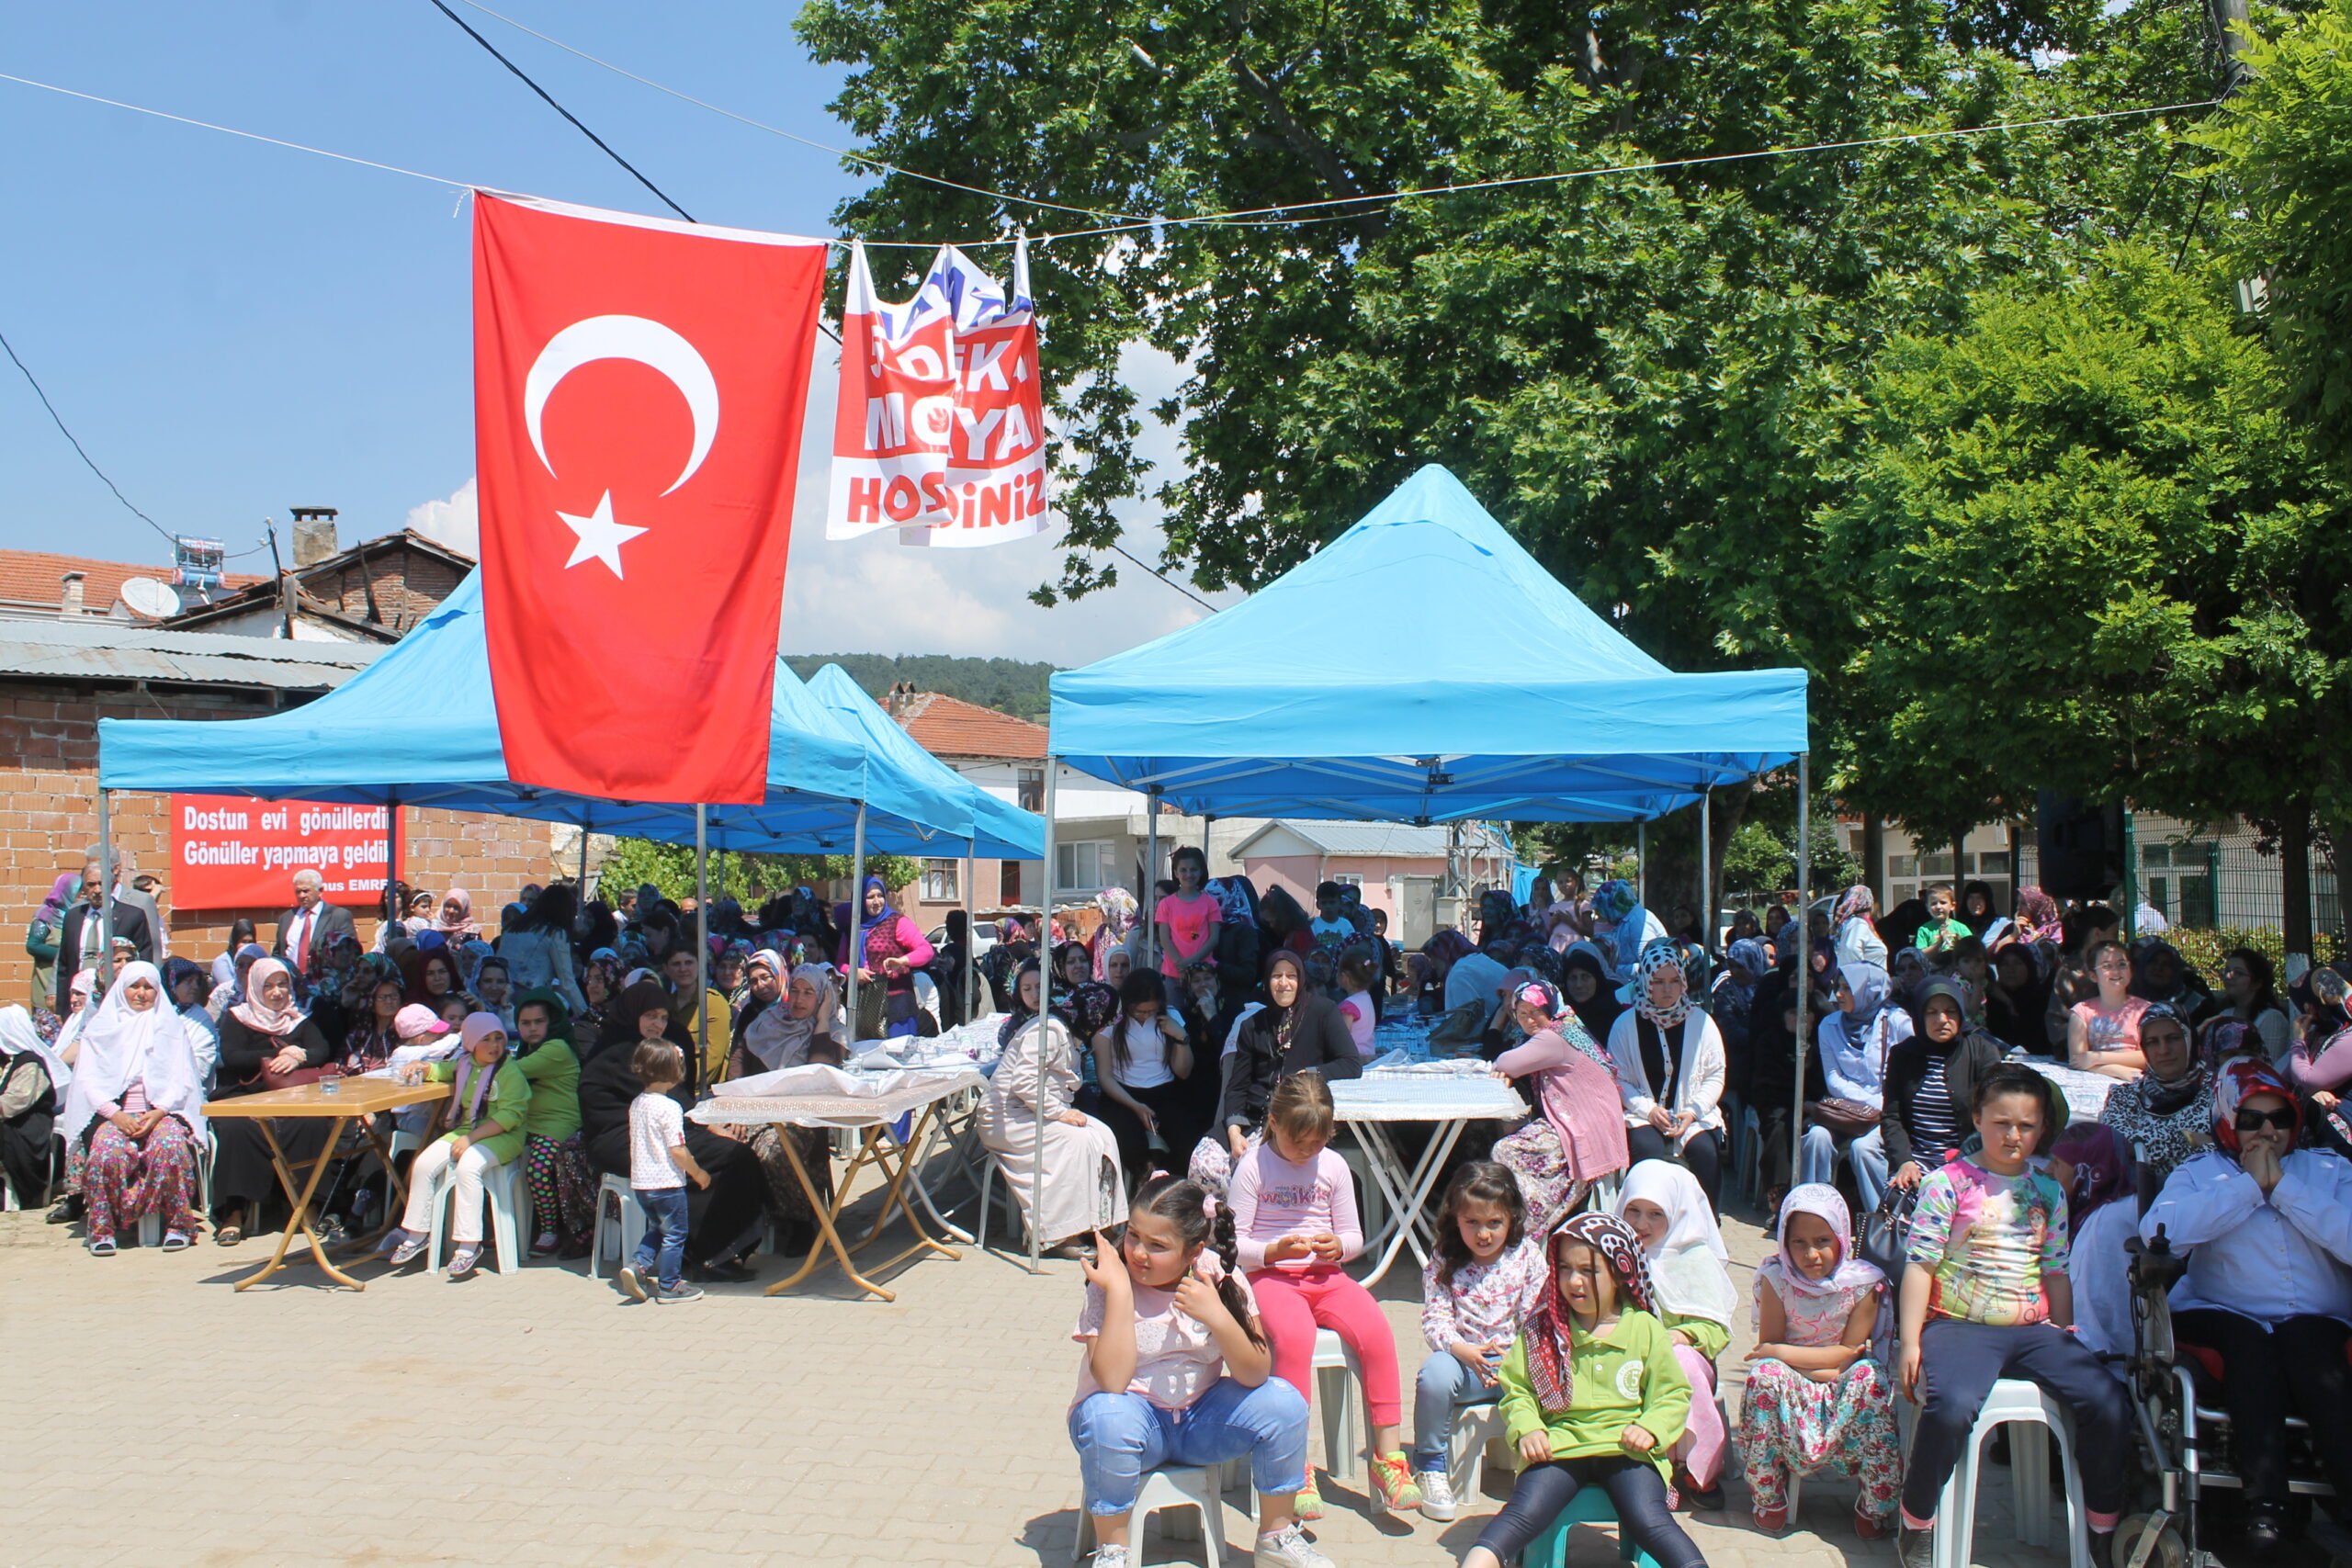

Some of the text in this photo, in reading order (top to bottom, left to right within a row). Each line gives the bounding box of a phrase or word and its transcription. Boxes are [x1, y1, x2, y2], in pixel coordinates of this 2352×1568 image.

[185, 807, 248, 830] Dostun
[261, 807, 288, 830] evi
[184, 840, 258, 865] Gönüller
[263, 841, 339, 870] yapmaya
